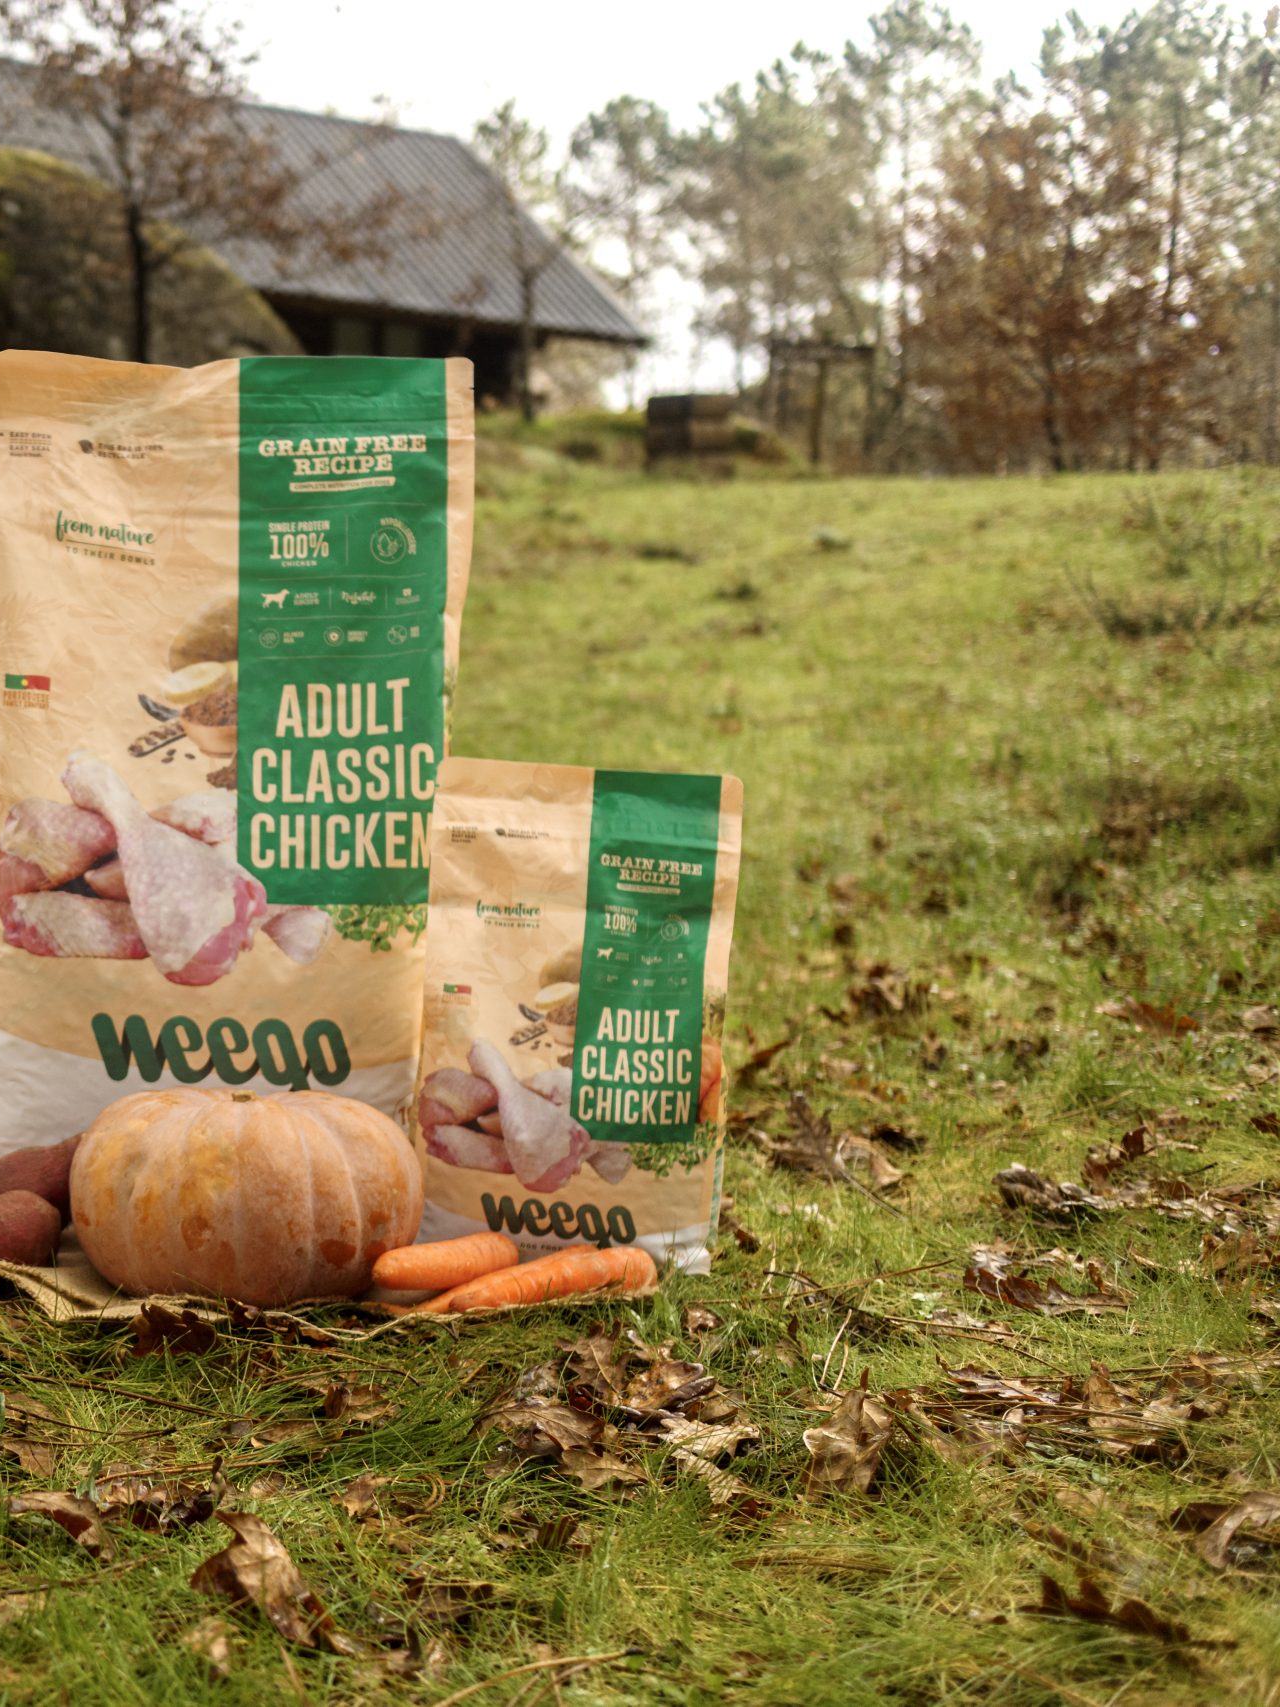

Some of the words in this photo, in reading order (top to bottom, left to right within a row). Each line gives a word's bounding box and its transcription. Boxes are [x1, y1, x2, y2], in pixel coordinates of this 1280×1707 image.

[259, 437, 349, 457] GRAIN
[354, 434, 427, 454] FREE
[293, 454, 393, 476] RECIPE
[56, 510, 95, 542] from
[99, 522, 156, 546] nature
[66, 545, 78, 555] TO
[84, 548, 115, 560] THEIR
[120, 553, 155, 566] BOWLS
[270, 532, 330, 559] 100%
[276, 678, 410, 738] ADULT
[252, 743, 436, 804] CLASSIC
[250, 811, 432, 870] CHICKEN
[601, 853, 655, 871] GRAIN
[658, 859, 703, 876] FREE
[620, 868, 680, 886] RECIPE
[477, 899, 502, 918] from
[504, 902, 540, 918] nature
[604, 912, 638, 934] 100%
[597, 1006, 680, 1045] ADULT
[581, 1045, 693, 1085] CLASSIC
[578, 1085, 692, 1126] CHICKEN
